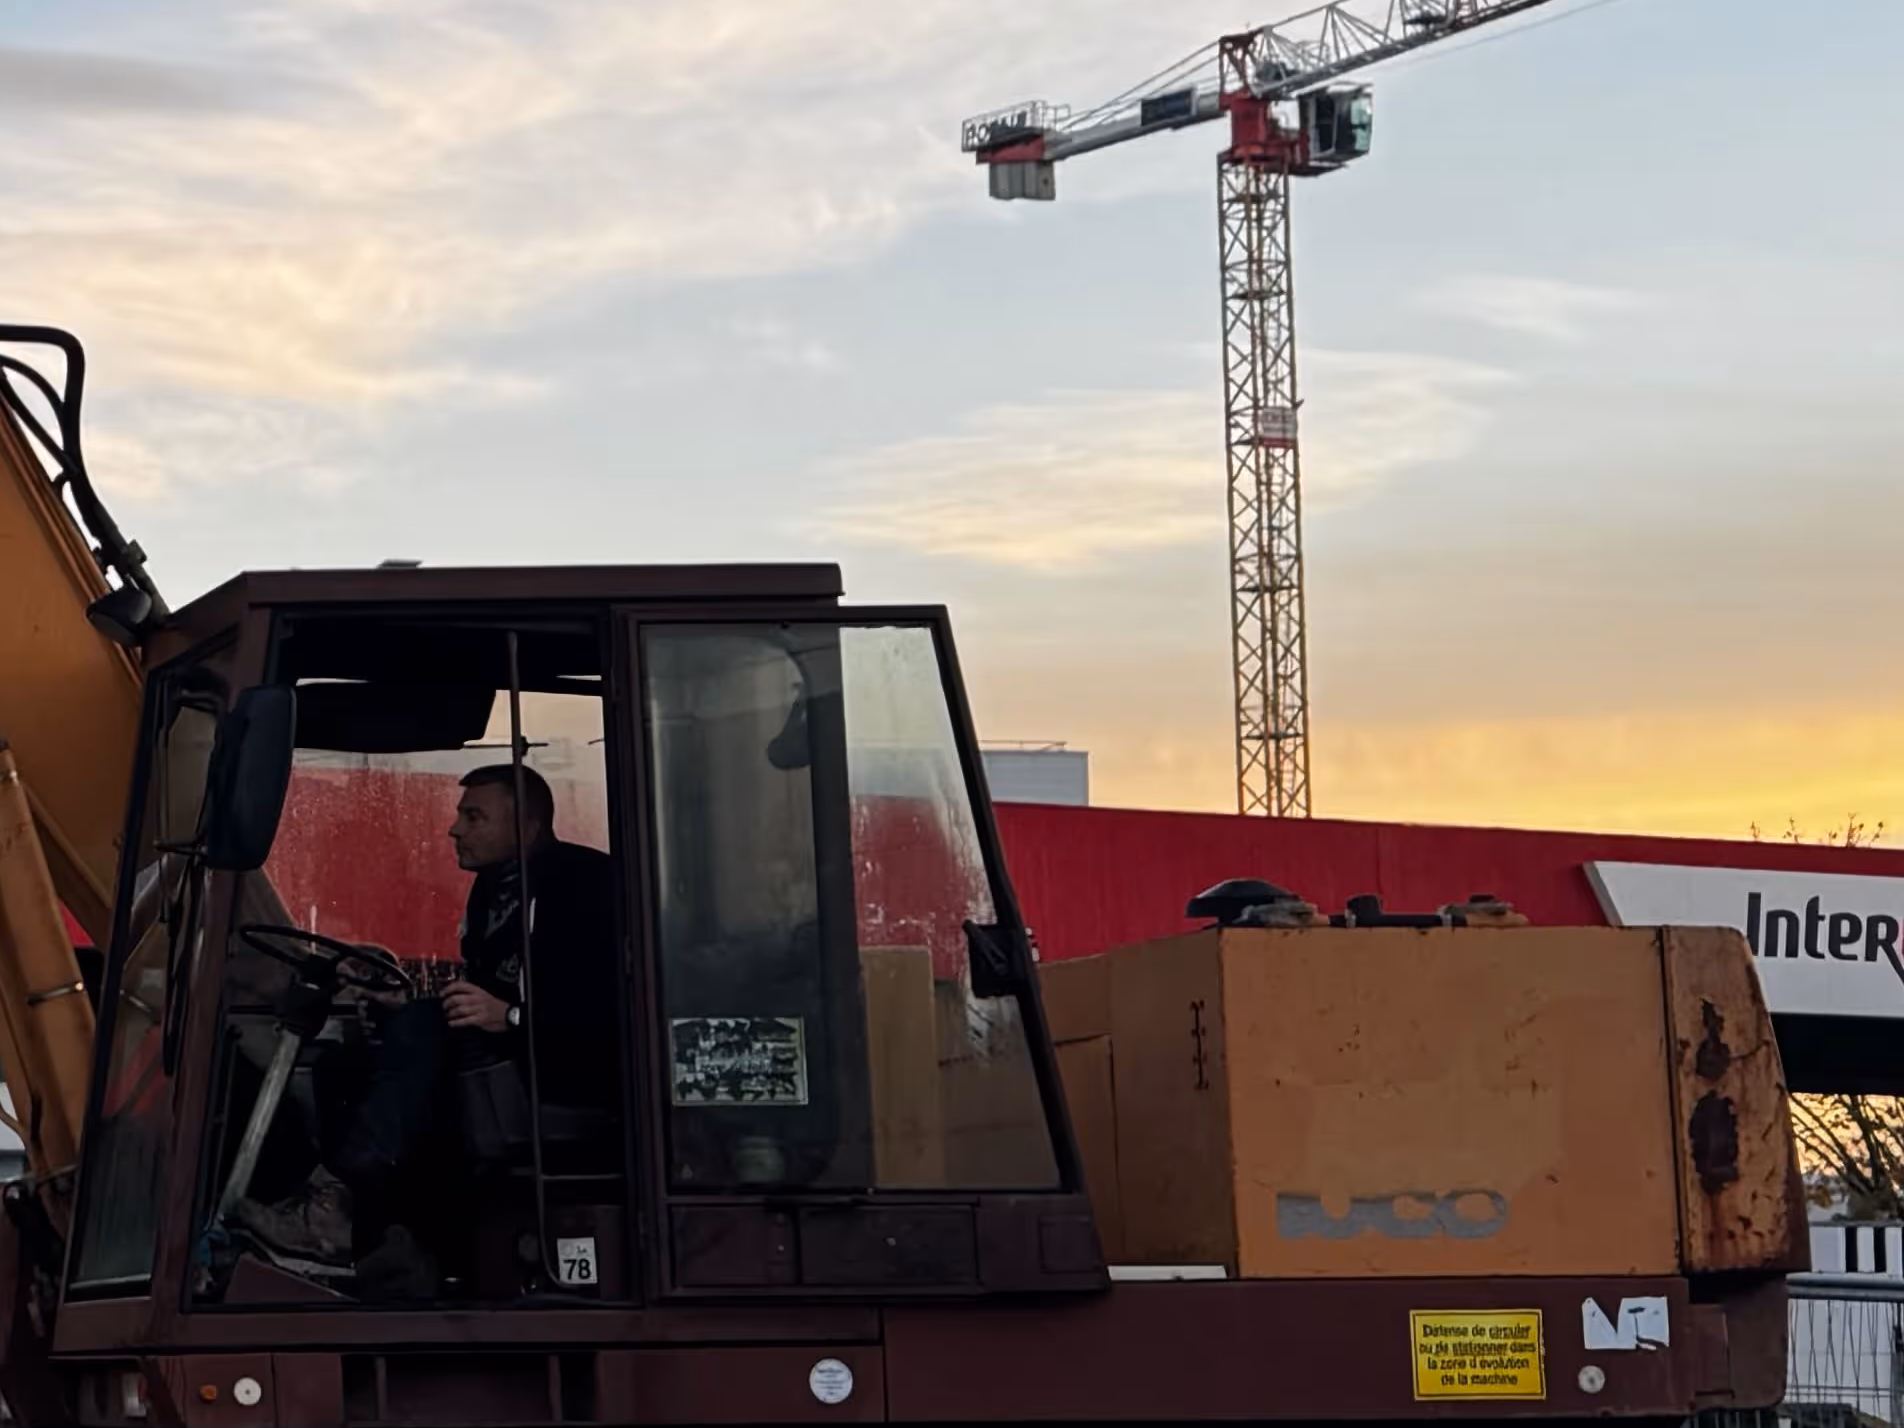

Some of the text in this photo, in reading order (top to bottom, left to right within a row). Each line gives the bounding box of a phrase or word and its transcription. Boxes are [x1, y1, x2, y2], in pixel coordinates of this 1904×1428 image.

[1747, 892, 1904, 984] Inter
[563, 1258, 591, 1280] 78
[1440, 1358, 1466, 1370] zone
[1471, 1373, 1518, 1386] machine
